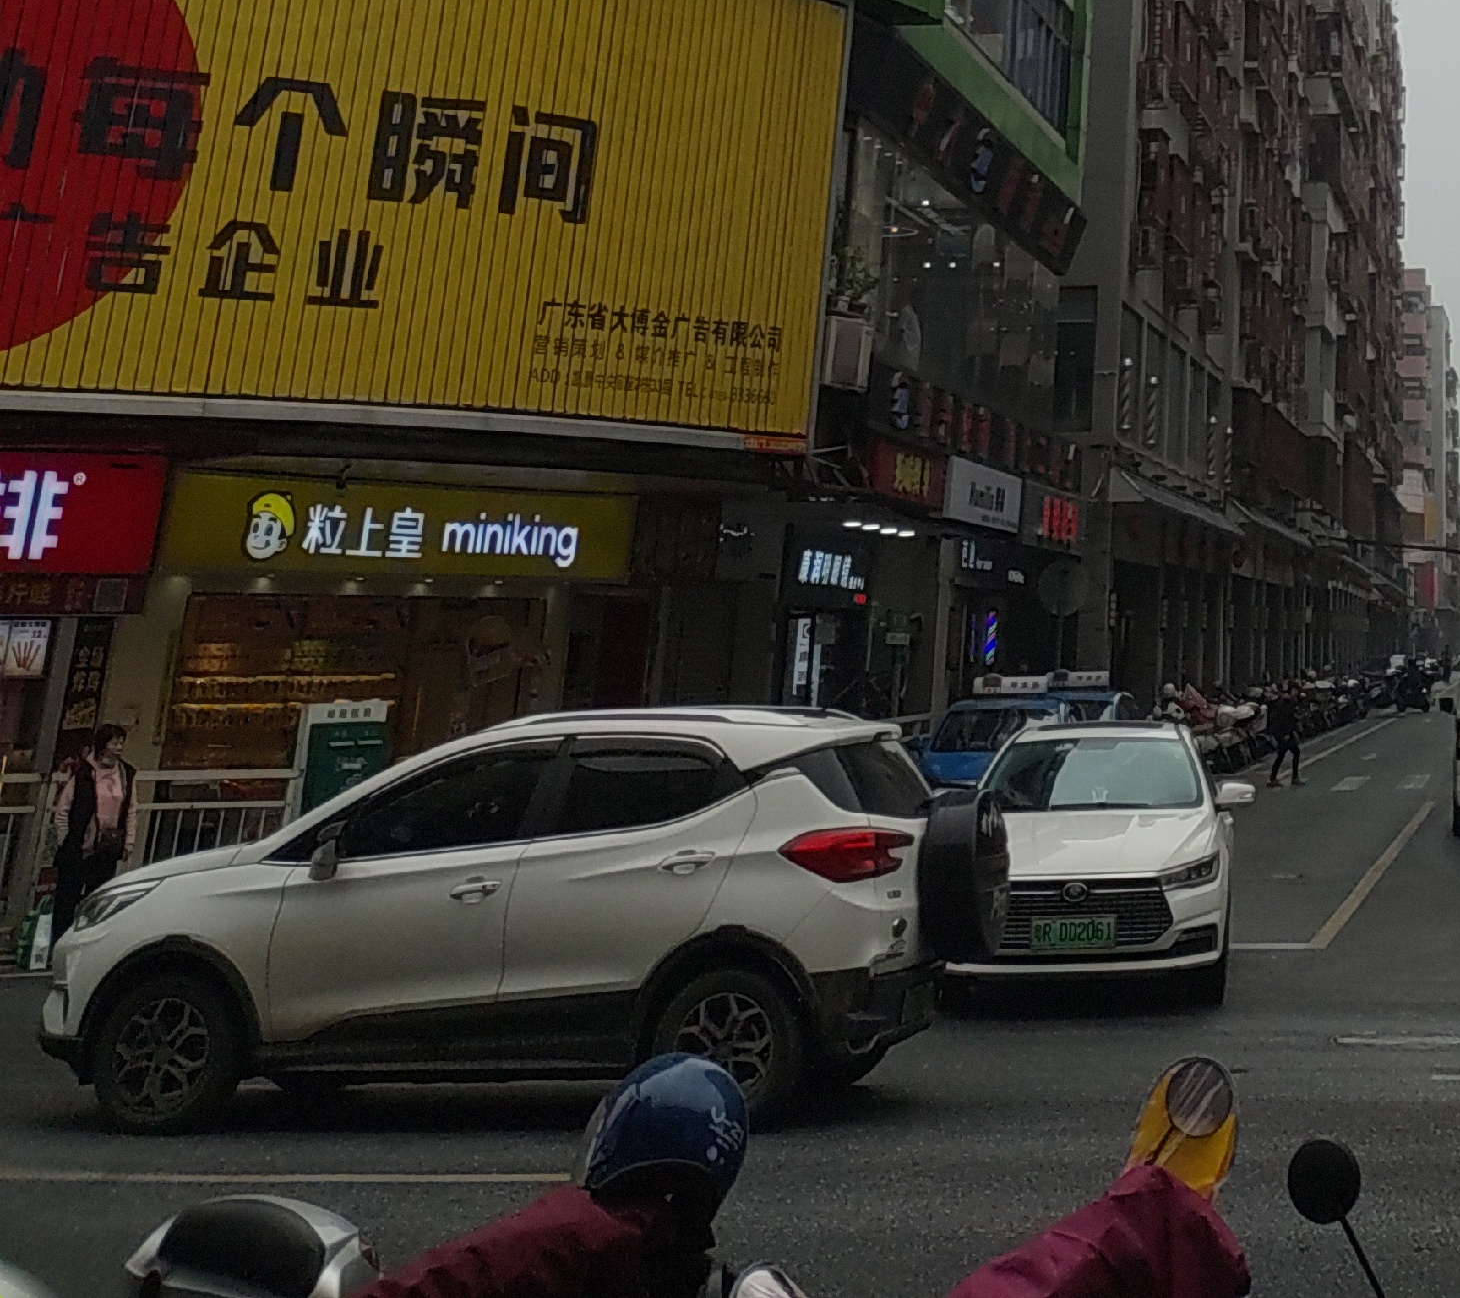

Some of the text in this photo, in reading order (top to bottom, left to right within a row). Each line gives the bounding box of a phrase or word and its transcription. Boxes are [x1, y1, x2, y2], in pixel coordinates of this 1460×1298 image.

[0, 207, 384, 309] 告企业
[537, 298, 783, 353] 广东省大博金广告有限公司
[301, 503, 580, 568] 粒上皇 miniking
